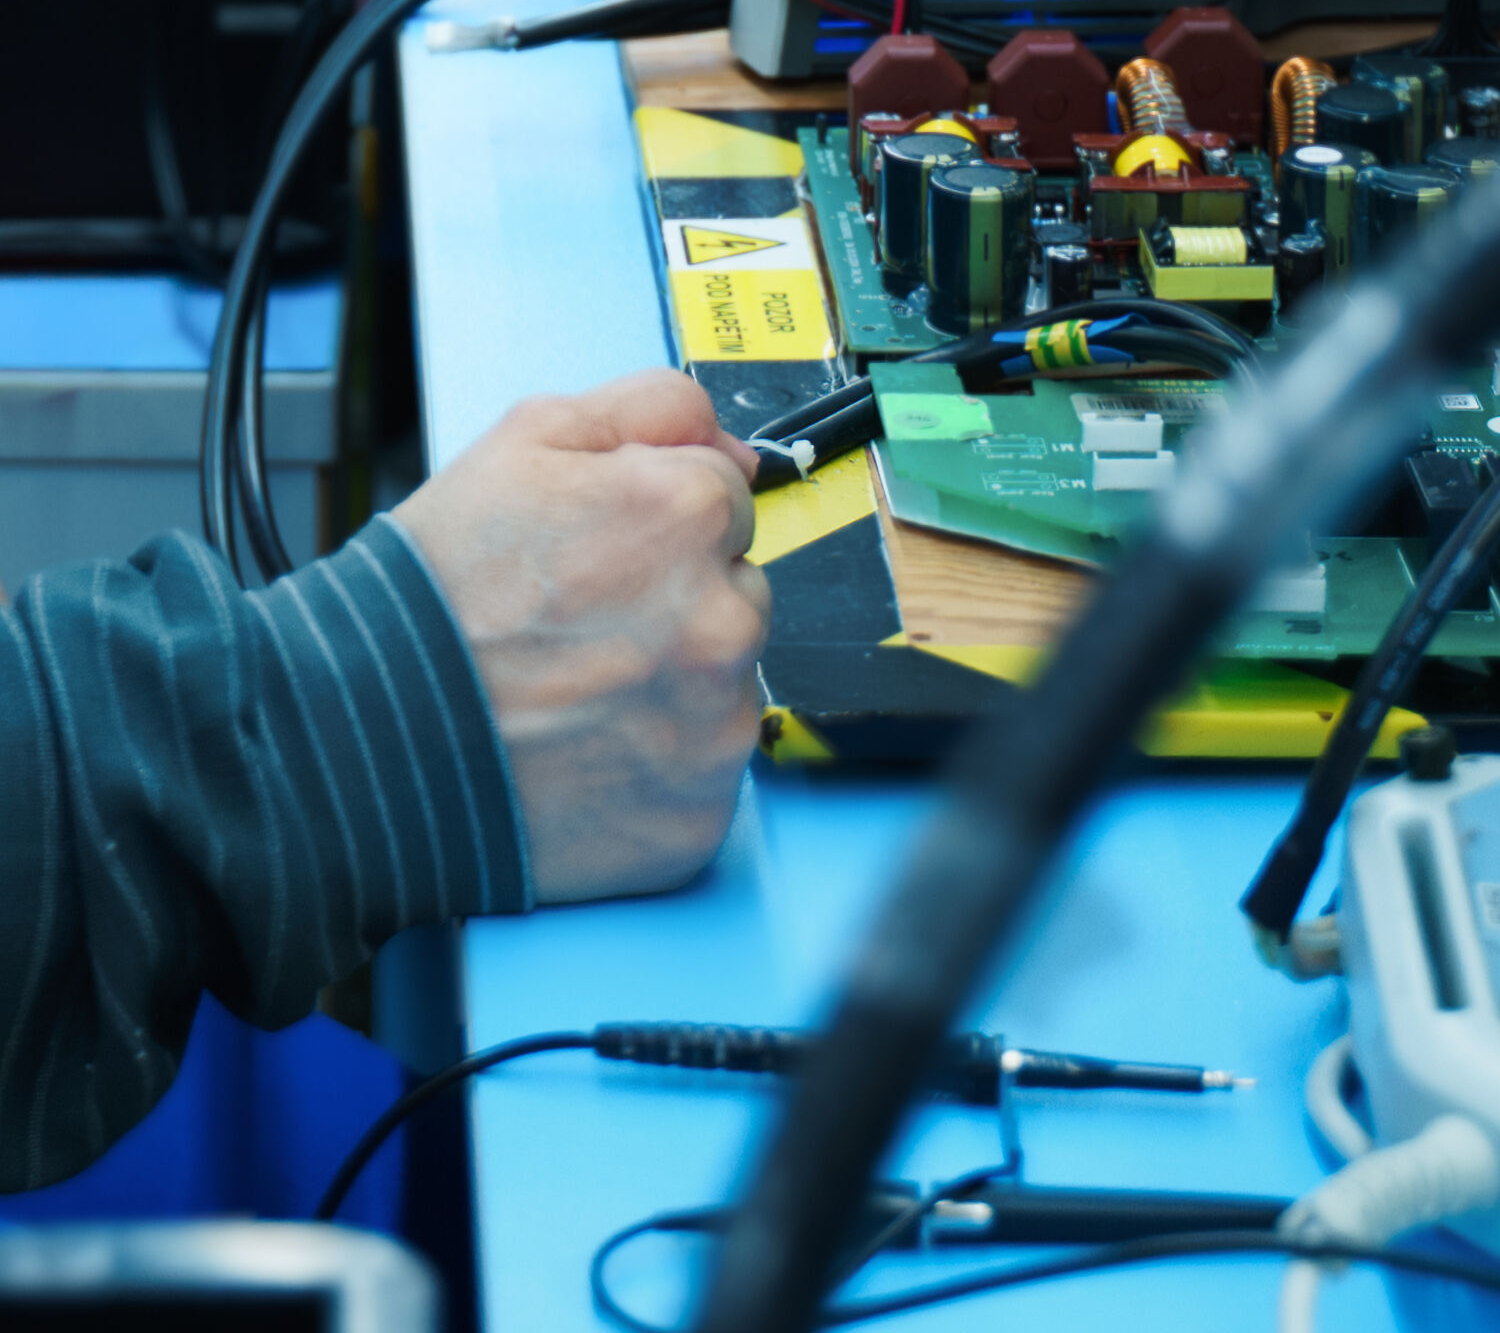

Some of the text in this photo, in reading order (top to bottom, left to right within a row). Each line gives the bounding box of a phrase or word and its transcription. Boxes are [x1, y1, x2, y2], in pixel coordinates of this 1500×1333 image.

[704, 275, 732, 298] POD
[762, 293, 795, 333] POZOR
[1051, 443, 1075, 453] M1
[1058, 478, 1087, 489] M3
